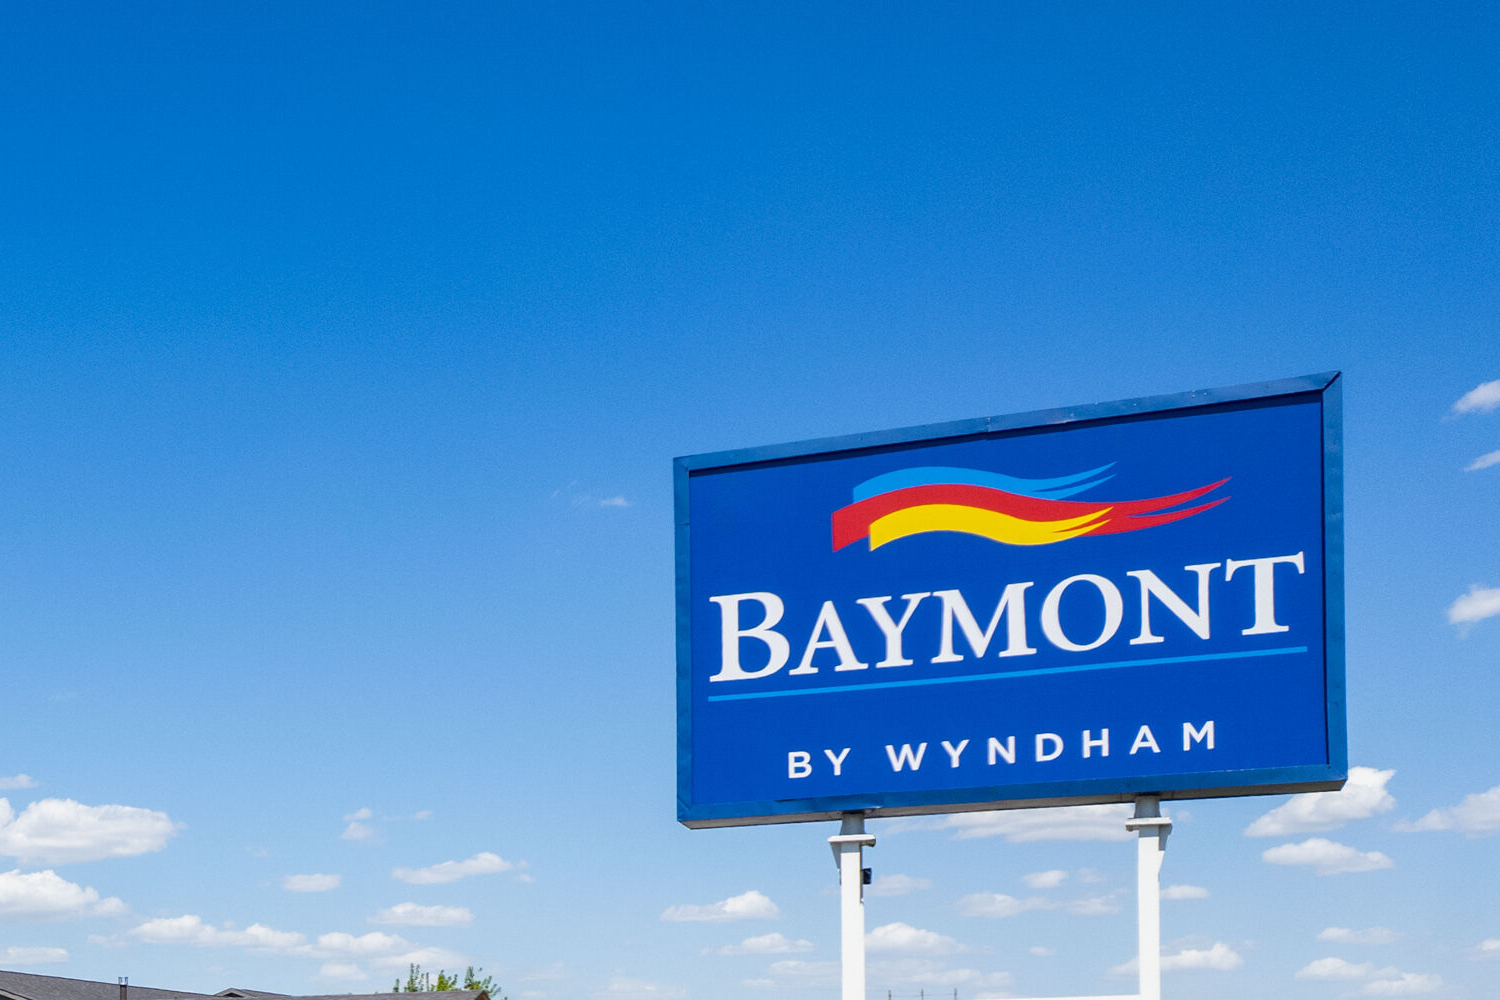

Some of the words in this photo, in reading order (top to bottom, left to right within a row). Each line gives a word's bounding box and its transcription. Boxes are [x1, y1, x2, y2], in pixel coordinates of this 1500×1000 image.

[708, 550, 1306, 684] BAYMONT
[787, 747, 852, 780] BY
[885, 719, 1216, 773] WYNDHAM
